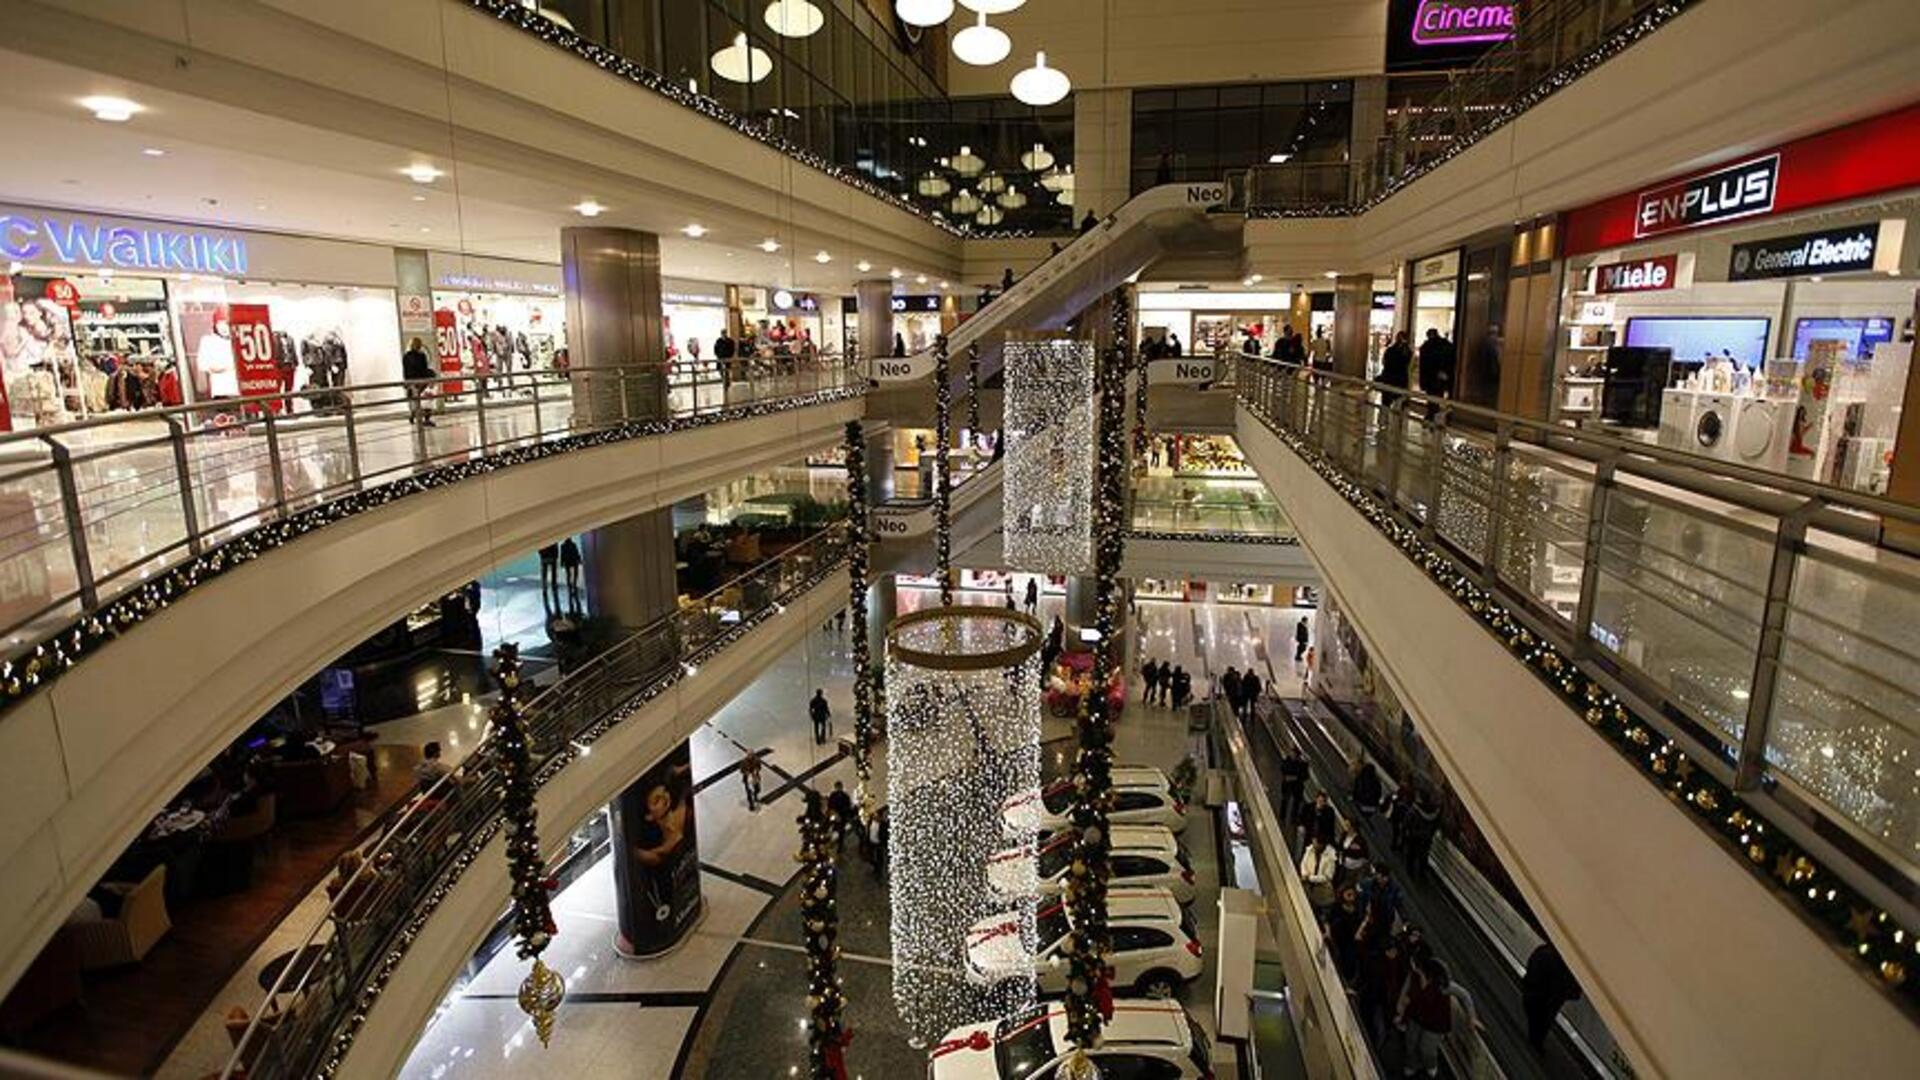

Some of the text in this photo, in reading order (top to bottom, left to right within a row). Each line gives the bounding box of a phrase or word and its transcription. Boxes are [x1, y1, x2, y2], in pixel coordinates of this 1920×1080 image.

[1423, 4, 1514, 30] cinema
[1187, 187, 1223, 202] Neo
[1641, 169, 1770, 226] ENPLUS
[1754, 233, 1872, 270] General Electric
[1603, 262, 1668, 290] Miele
[879, 363, 911, 376] Neo
[1176, 363, 1212, 378] Neo
[877, 515, 907, 533] Neo
